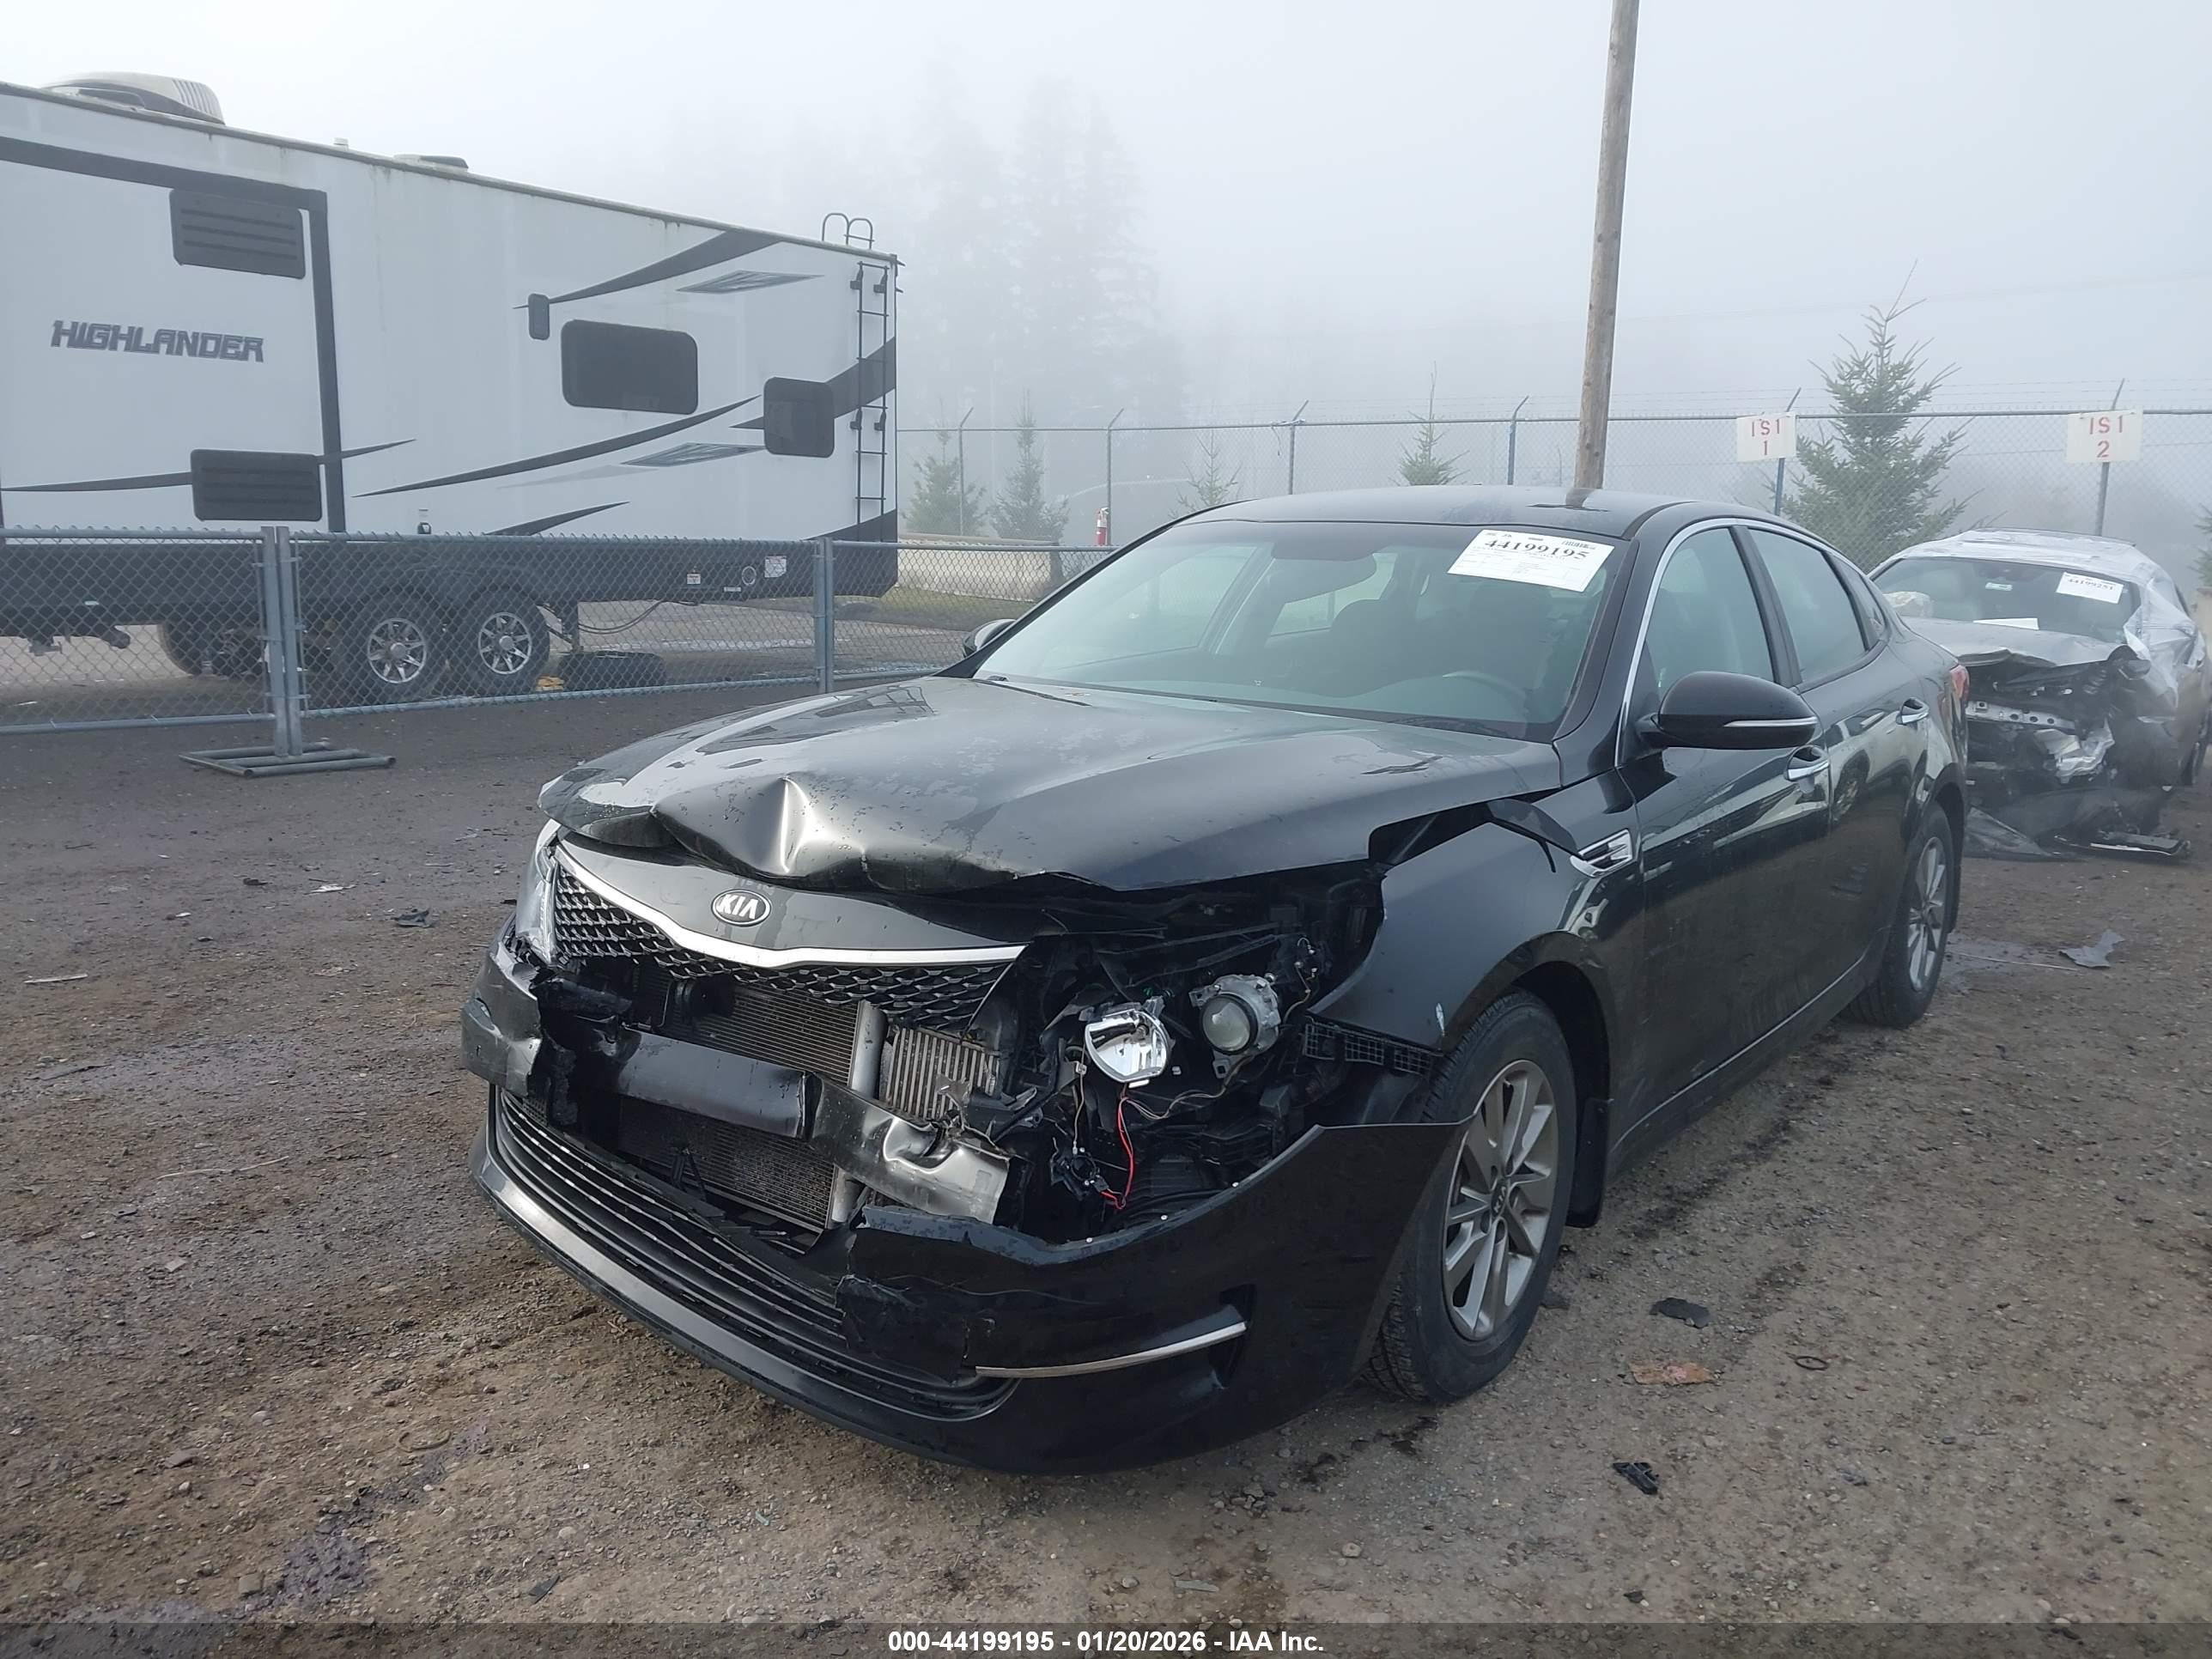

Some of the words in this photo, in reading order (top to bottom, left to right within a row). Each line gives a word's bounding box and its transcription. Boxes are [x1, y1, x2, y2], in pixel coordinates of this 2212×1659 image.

[50, 319, 264, 362] HIGHLANDER
[2096, 440, 2110, 458] 2
[1484, 539, 1590, 560] 44199195
[715, 893, 759, 920] KIA
